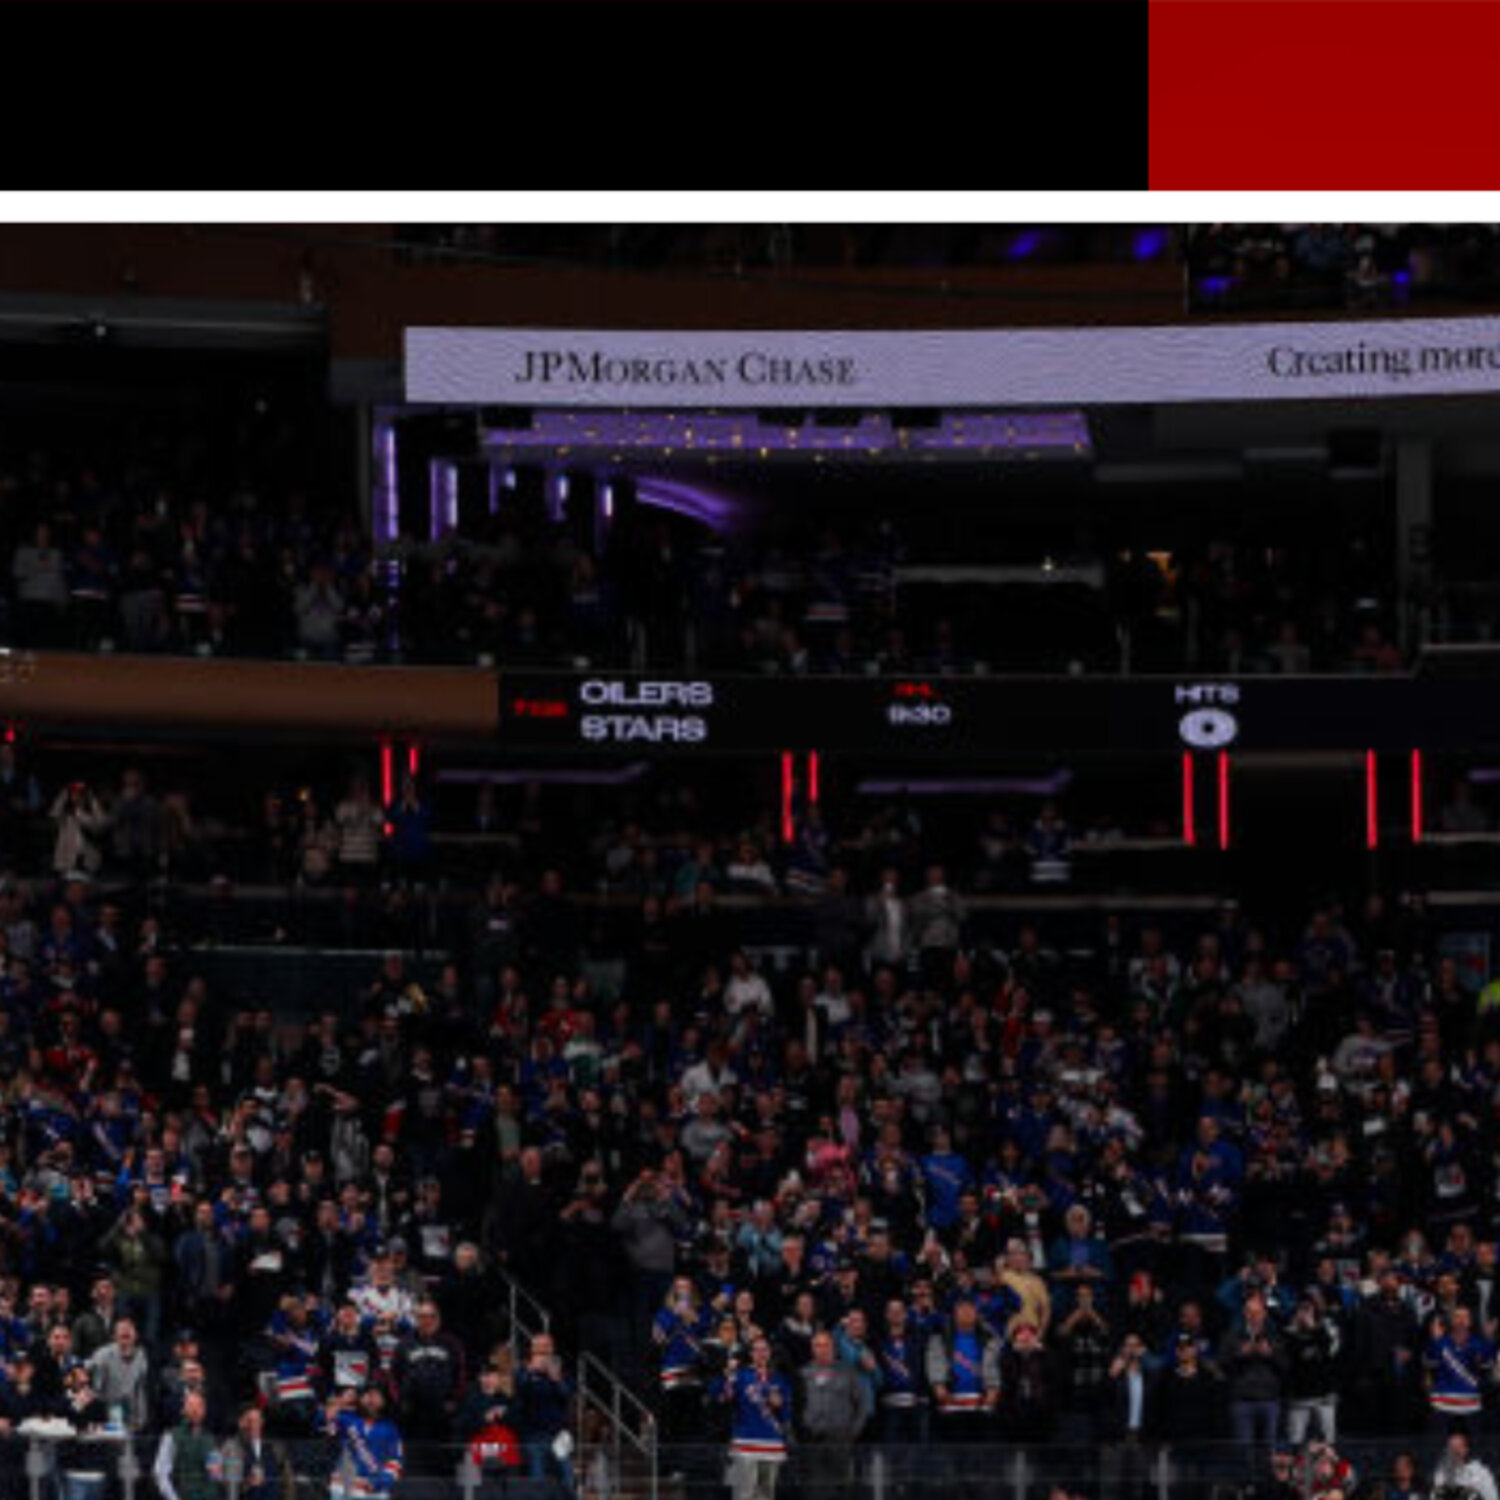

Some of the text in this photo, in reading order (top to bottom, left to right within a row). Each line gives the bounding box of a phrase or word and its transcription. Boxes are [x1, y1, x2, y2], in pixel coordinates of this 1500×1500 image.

[736, 352, 857, 386] CHASE
[1266, 340, 1410, 378] Creating
[580, 681, 713, 705] OILERS
[580, 715, 706, 742] STARS
